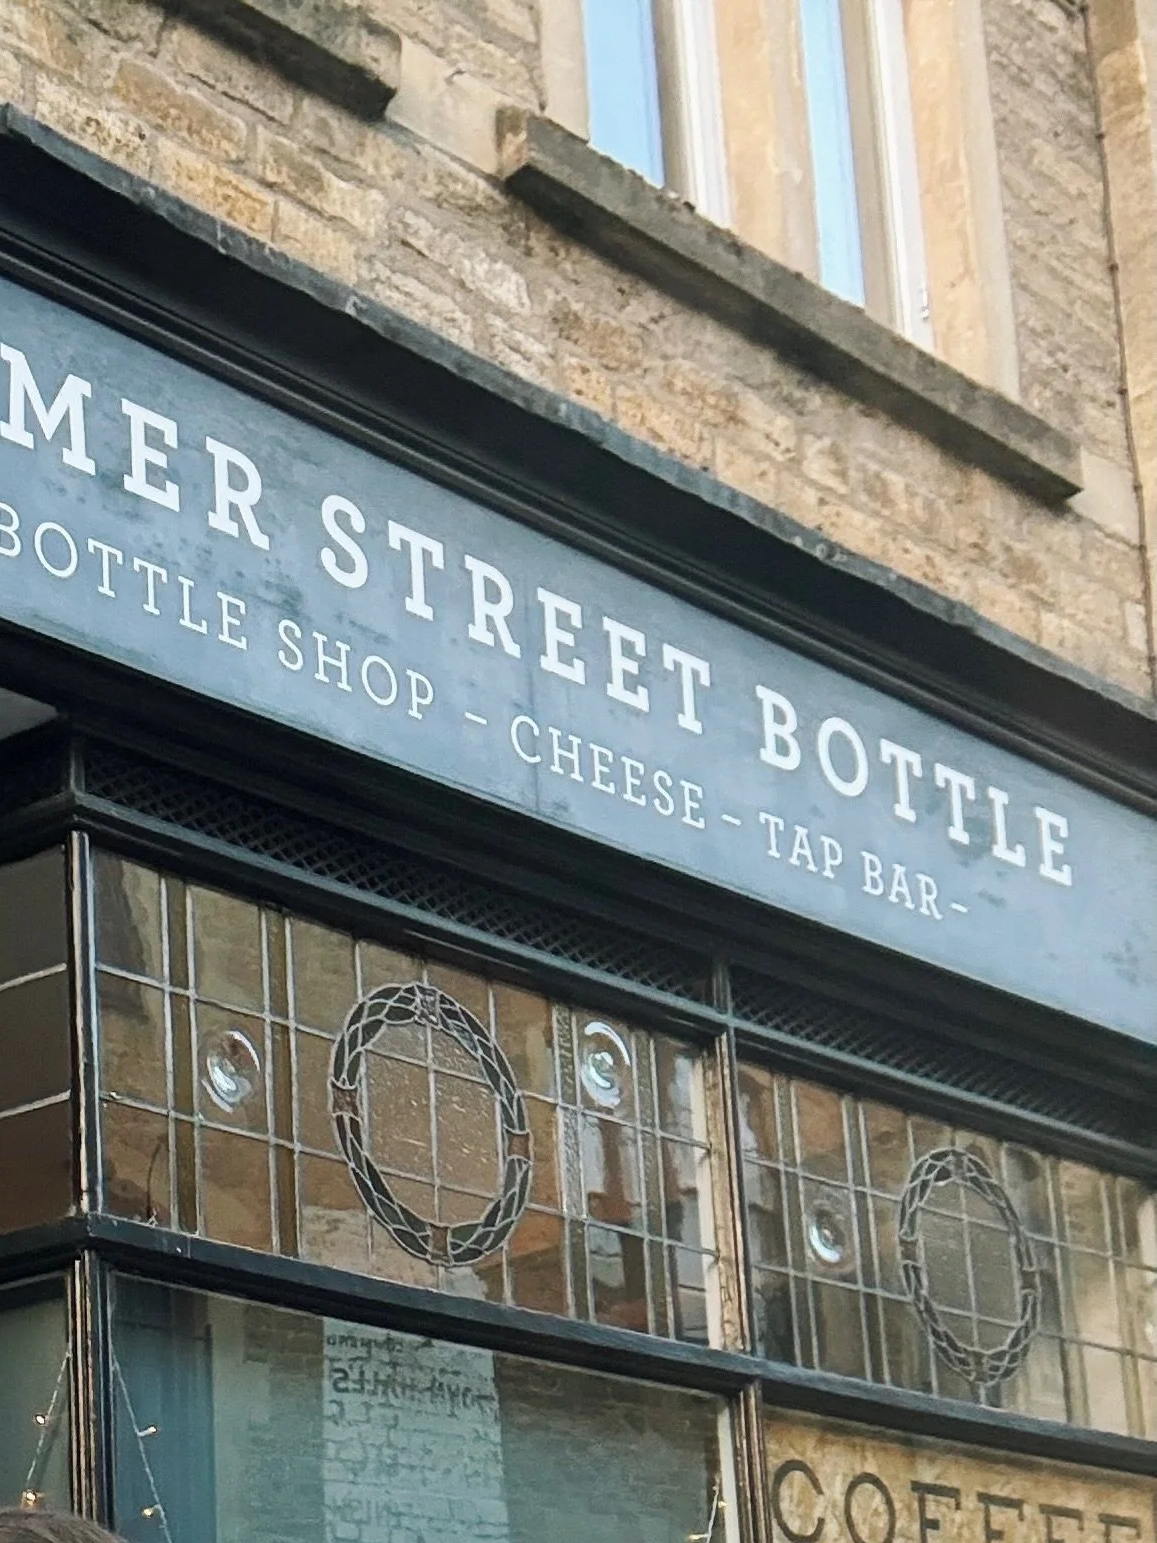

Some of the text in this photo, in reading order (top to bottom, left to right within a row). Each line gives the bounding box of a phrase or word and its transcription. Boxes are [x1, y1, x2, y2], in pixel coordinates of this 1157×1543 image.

[277, 619, 436, 720] SHOP
[509, 714, 706, 830] CHEESE
[758, 811, 843, 881] TAP
[320, 494, 711, 736] STREET
[755, 684, 1073, 888] BOTTLE
